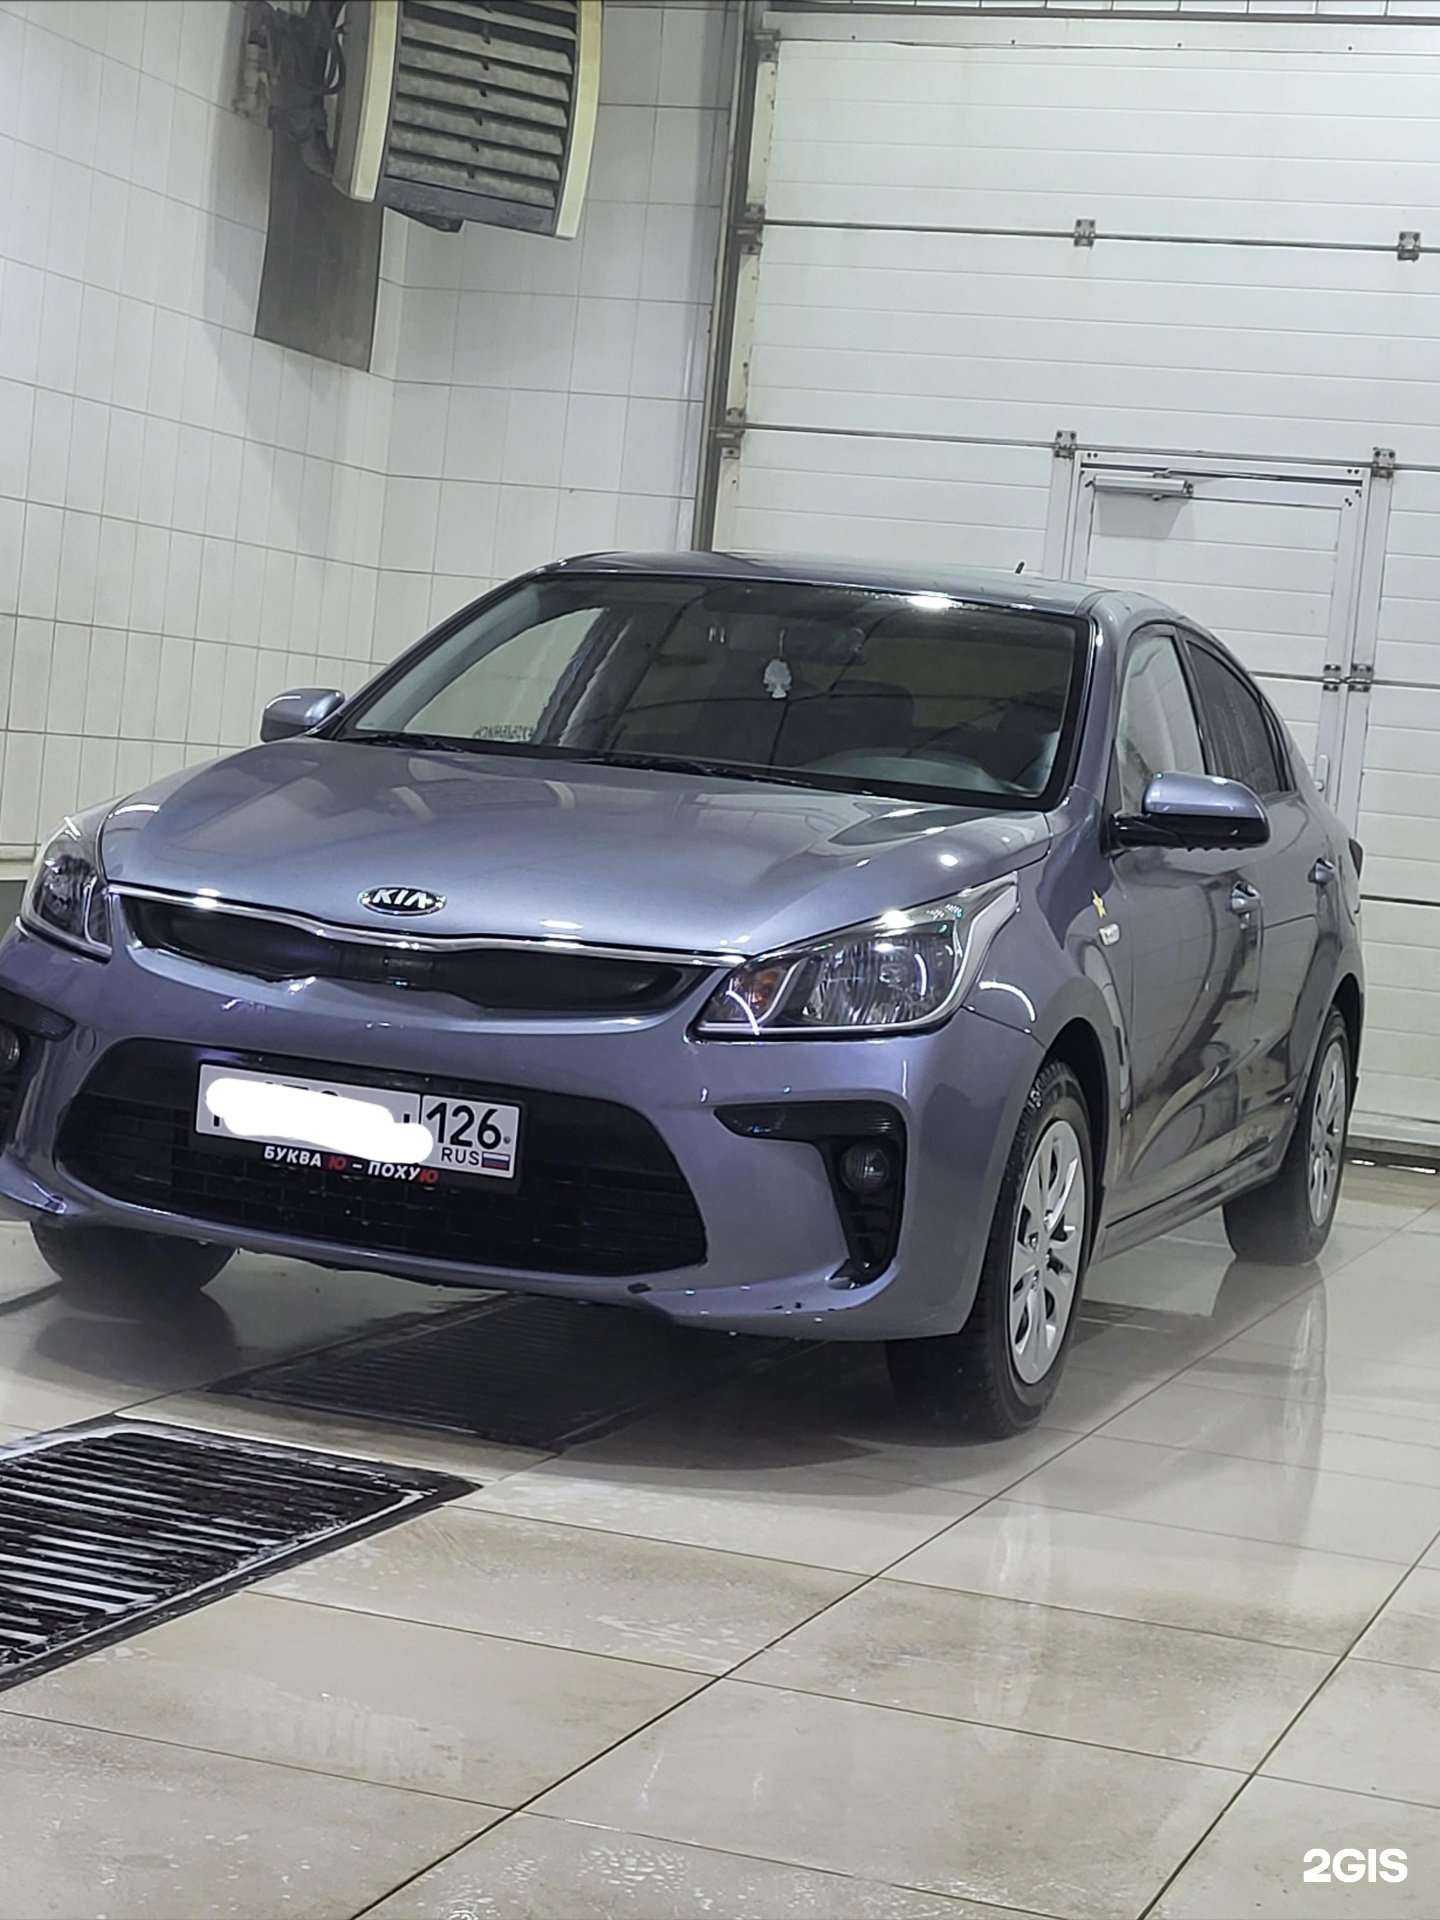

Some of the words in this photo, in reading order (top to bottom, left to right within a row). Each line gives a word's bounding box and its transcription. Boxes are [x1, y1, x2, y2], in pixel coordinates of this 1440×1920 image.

[372, 889, 434, 909] KIA
[426, 1102, 502, 1150] 126
[264, 1145, 321, 1168] БУКВА
[326, 1155, 347, 1170] Ю
[368, 1161, 439, 1184] ПОХУЮ
[441, 1147, 480, 1166] RUS
